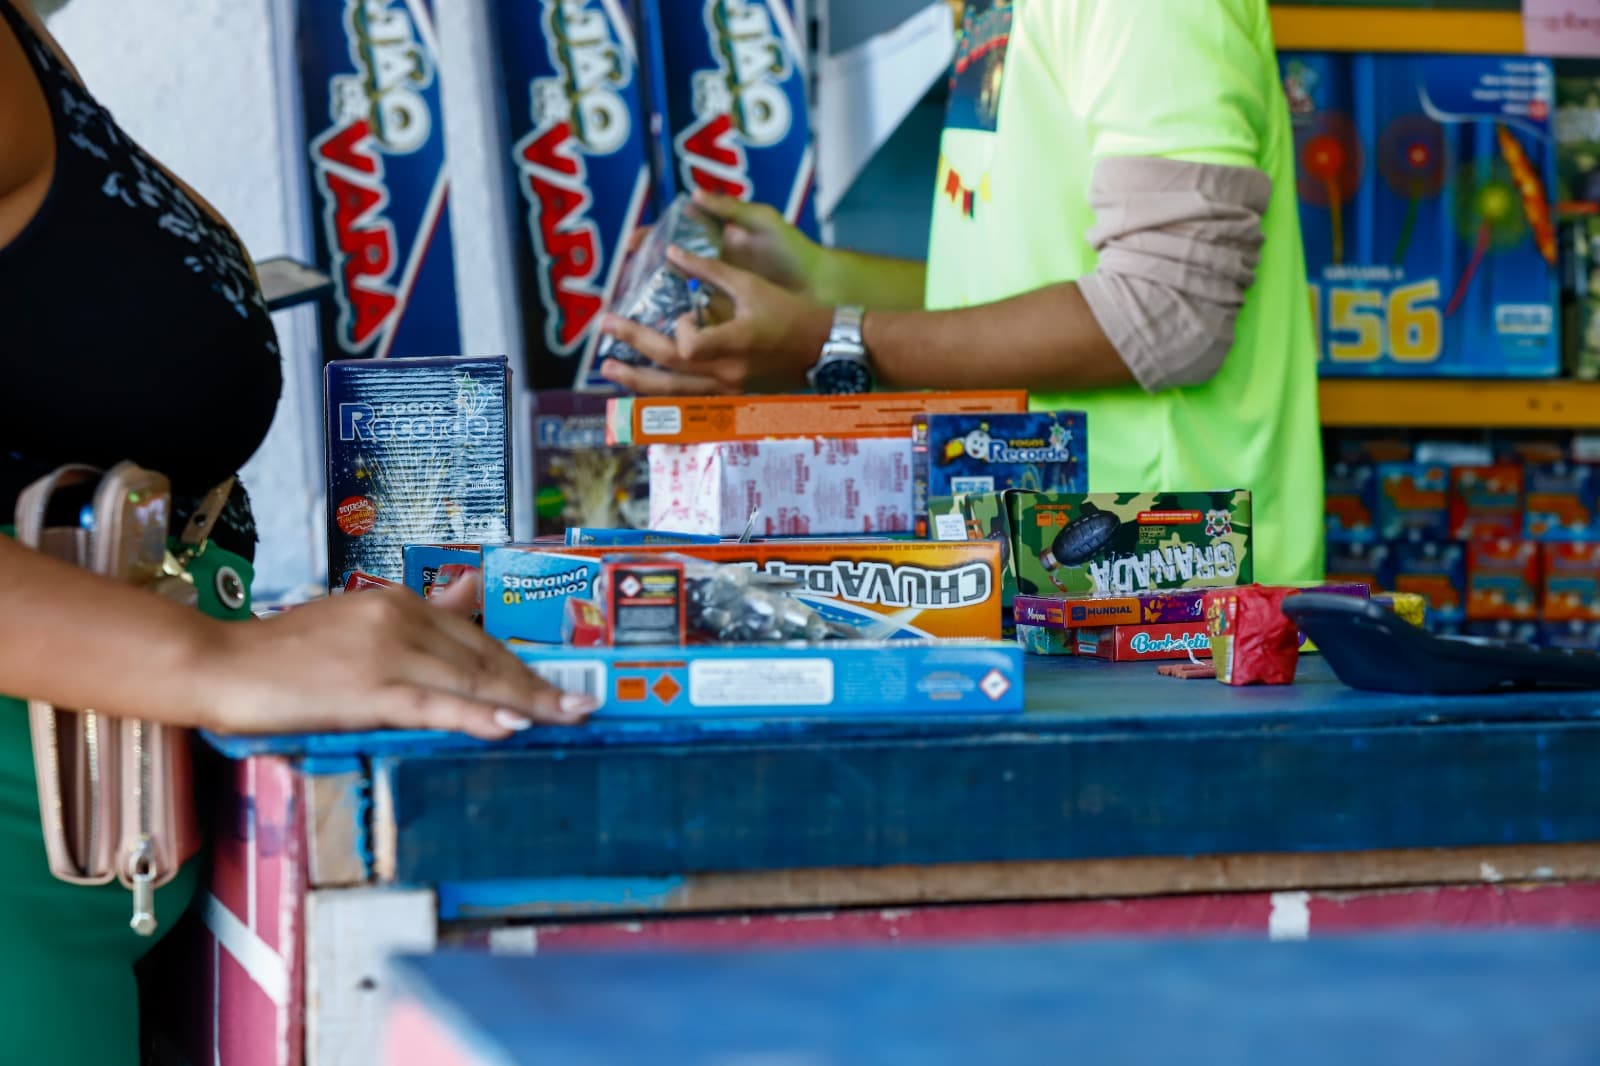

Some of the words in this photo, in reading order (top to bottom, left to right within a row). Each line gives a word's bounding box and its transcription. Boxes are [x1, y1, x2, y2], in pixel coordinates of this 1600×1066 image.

[683, 113, 748, 200] VA
[317, 118, 399, 346] VARA
[521, 121, 604, 348] VARA
[339, 403, 490, 441] Recorde
[988, 438, 1069, 463] Recorde
[502, 565, 588, 589] UNIDADES
[836, 563, 990, 608] CHUVA
[1089, 543, 1237, 596] GRANADA
[502, 590, 522, 605] 10
[1087, 605, 1132, 616] MUNDIAL
